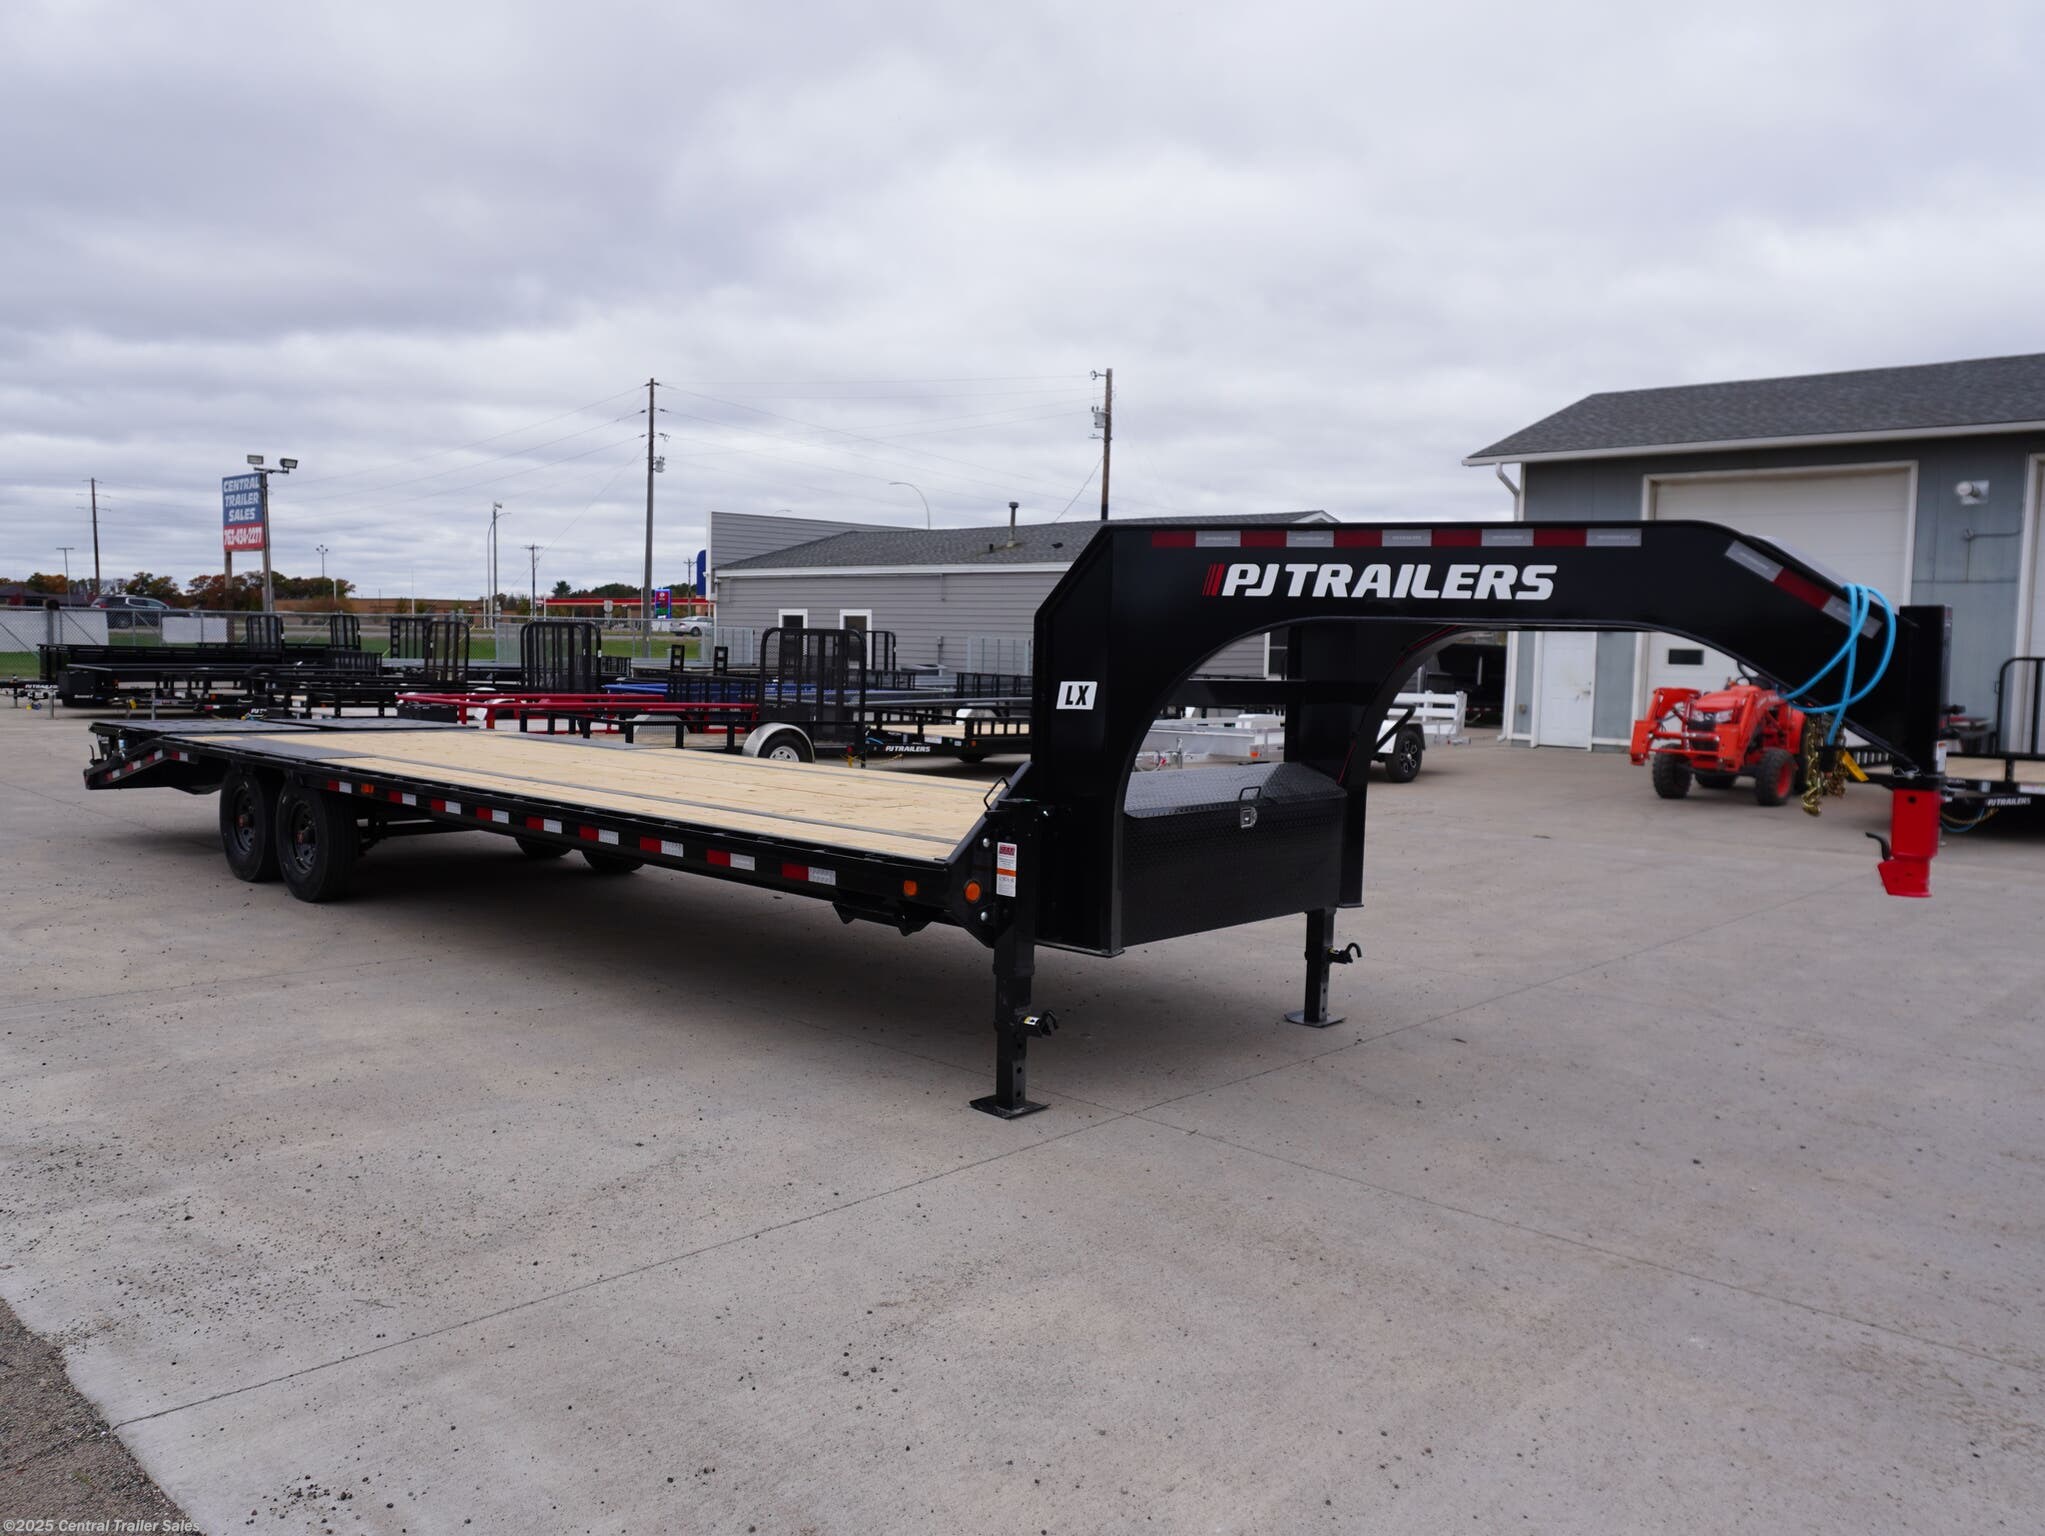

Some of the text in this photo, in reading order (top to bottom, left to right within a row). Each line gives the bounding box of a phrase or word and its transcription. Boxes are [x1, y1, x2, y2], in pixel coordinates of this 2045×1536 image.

[223, 477, 259, 492] CENTRAL
[225, 492, 259, 507] TRAILER
[229, 508, 255, 522] SALES
[1065, 685, 1090, 706] LX
